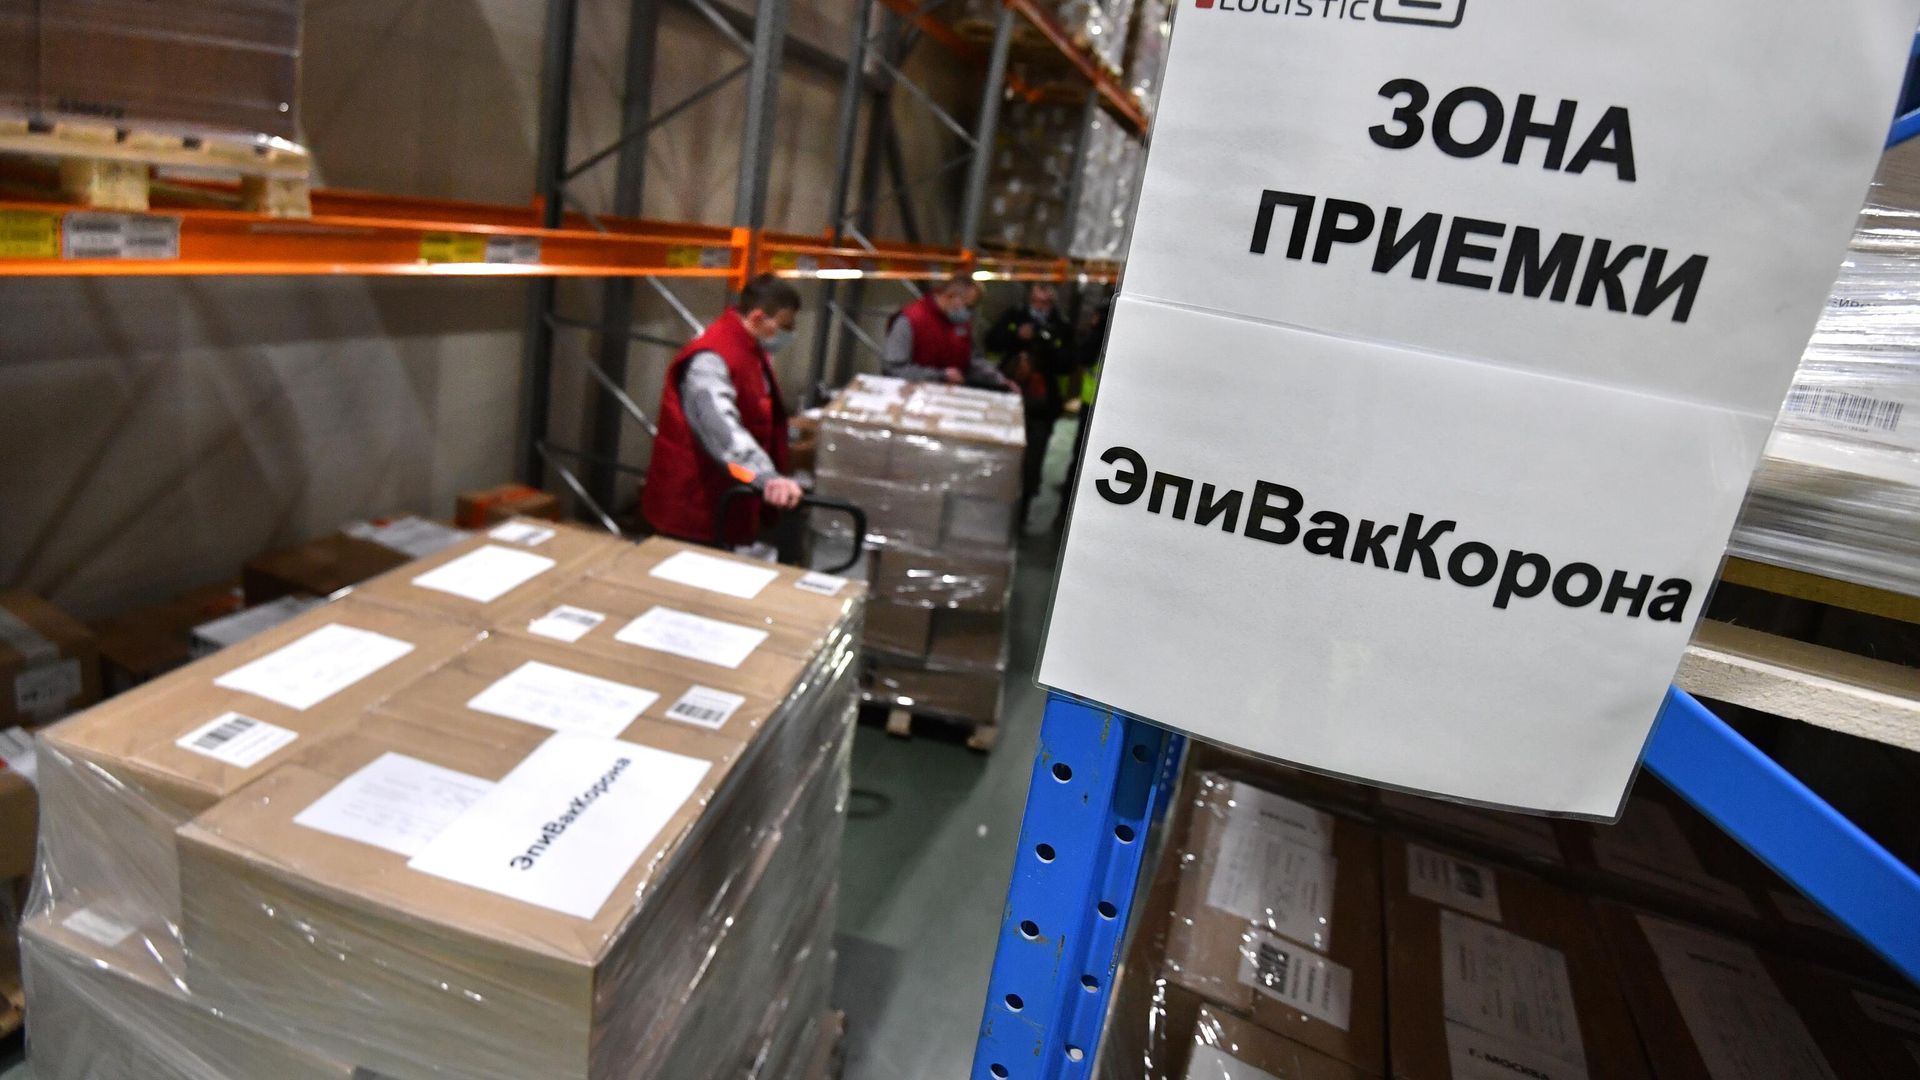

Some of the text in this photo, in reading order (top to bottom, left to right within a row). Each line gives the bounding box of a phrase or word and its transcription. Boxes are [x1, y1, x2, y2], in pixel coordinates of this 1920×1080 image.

[1368, 78, 1637, 183] ЗОНА
[1249, 189, 1709, 323] ПРИЕМКИ
[1095, 446, 1693, 623] ЭпиВакКорона
[509, 756, 631, 871] ЭпиВакКорона
